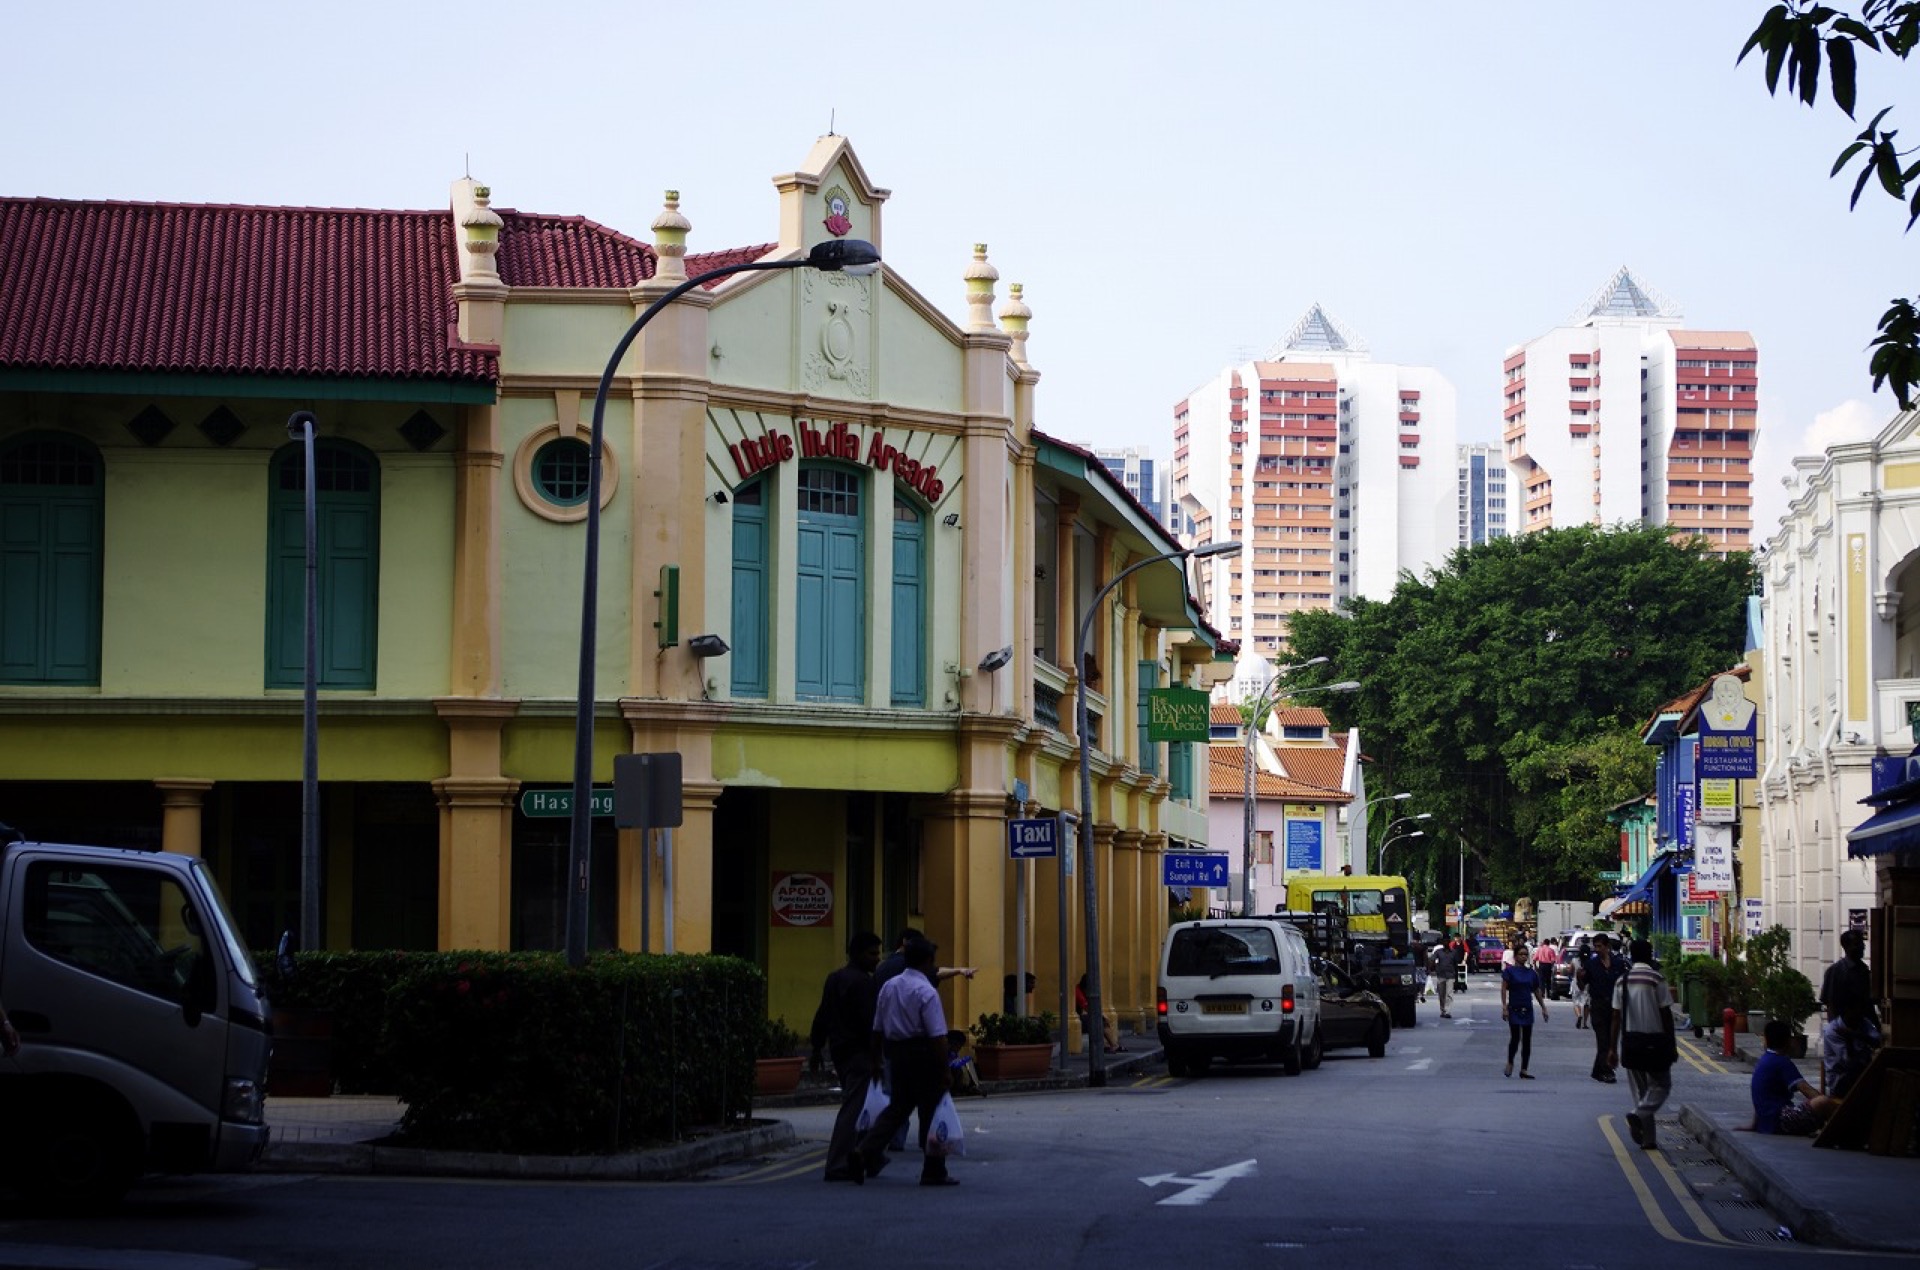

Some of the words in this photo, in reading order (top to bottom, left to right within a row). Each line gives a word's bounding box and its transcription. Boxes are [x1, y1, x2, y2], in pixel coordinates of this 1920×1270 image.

[730, 428, 793, 480] Little
[799, 420, 860, 461] India
[867, 432, 944, 503] Arcade
[1703, 756, 1753, 764] RESTAURANT
[1013, 822, 1051, 844] Taxi
[1175, 859, 1190, 869] Exit
[1195, 859, 1203, 869] to
[1169, 871, 1194, 882] Sungei
[1199, 871, 1209, 881] Rd
[779, 887, 826, 896] APOLO
